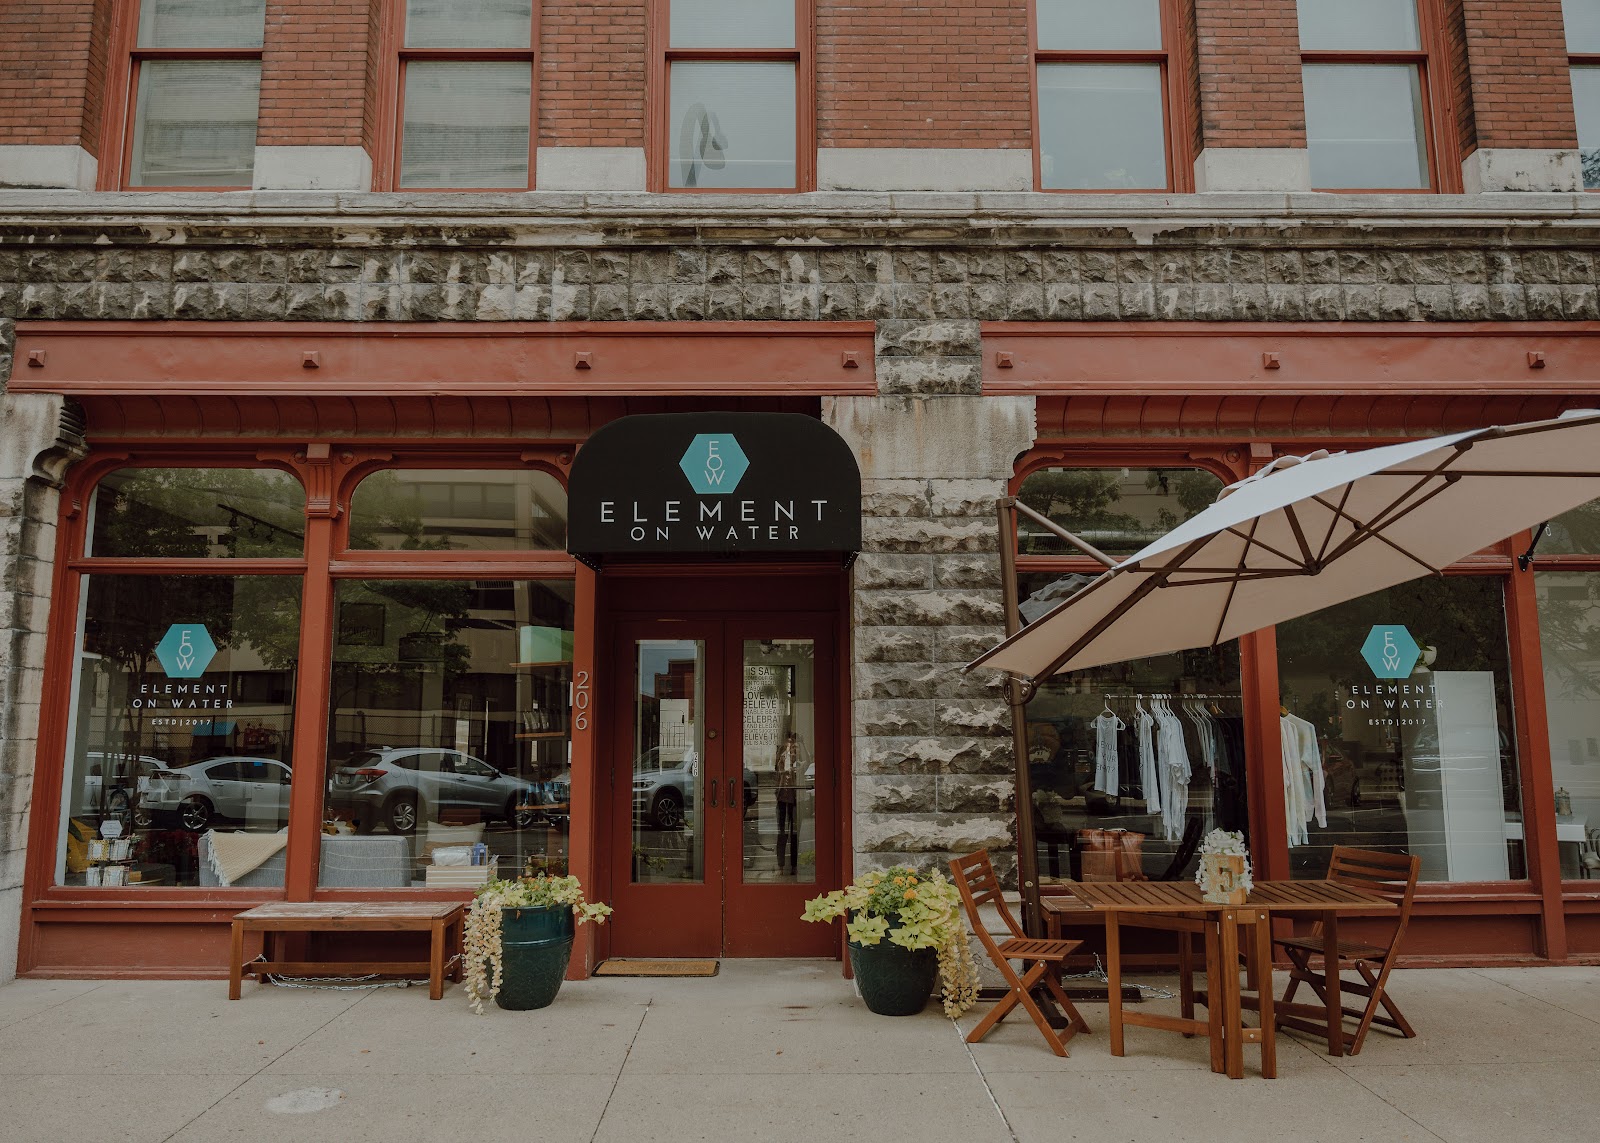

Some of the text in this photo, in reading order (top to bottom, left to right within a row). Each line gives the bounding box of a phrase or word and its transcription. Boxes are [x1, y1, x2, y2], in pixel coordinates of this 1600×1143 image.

[600, 500, 828, 523] ELEMENT
[630, 525, 799, 541] ON WATER
[141, 684, 228, 694] ELEMENT
[1352, 685, 1436, 694] ELEMENT
[132, 698, 233, 709] ON WATER
[575, 670, 589, 730] 206
[1346, 699, 1444, 709] ON WATER
